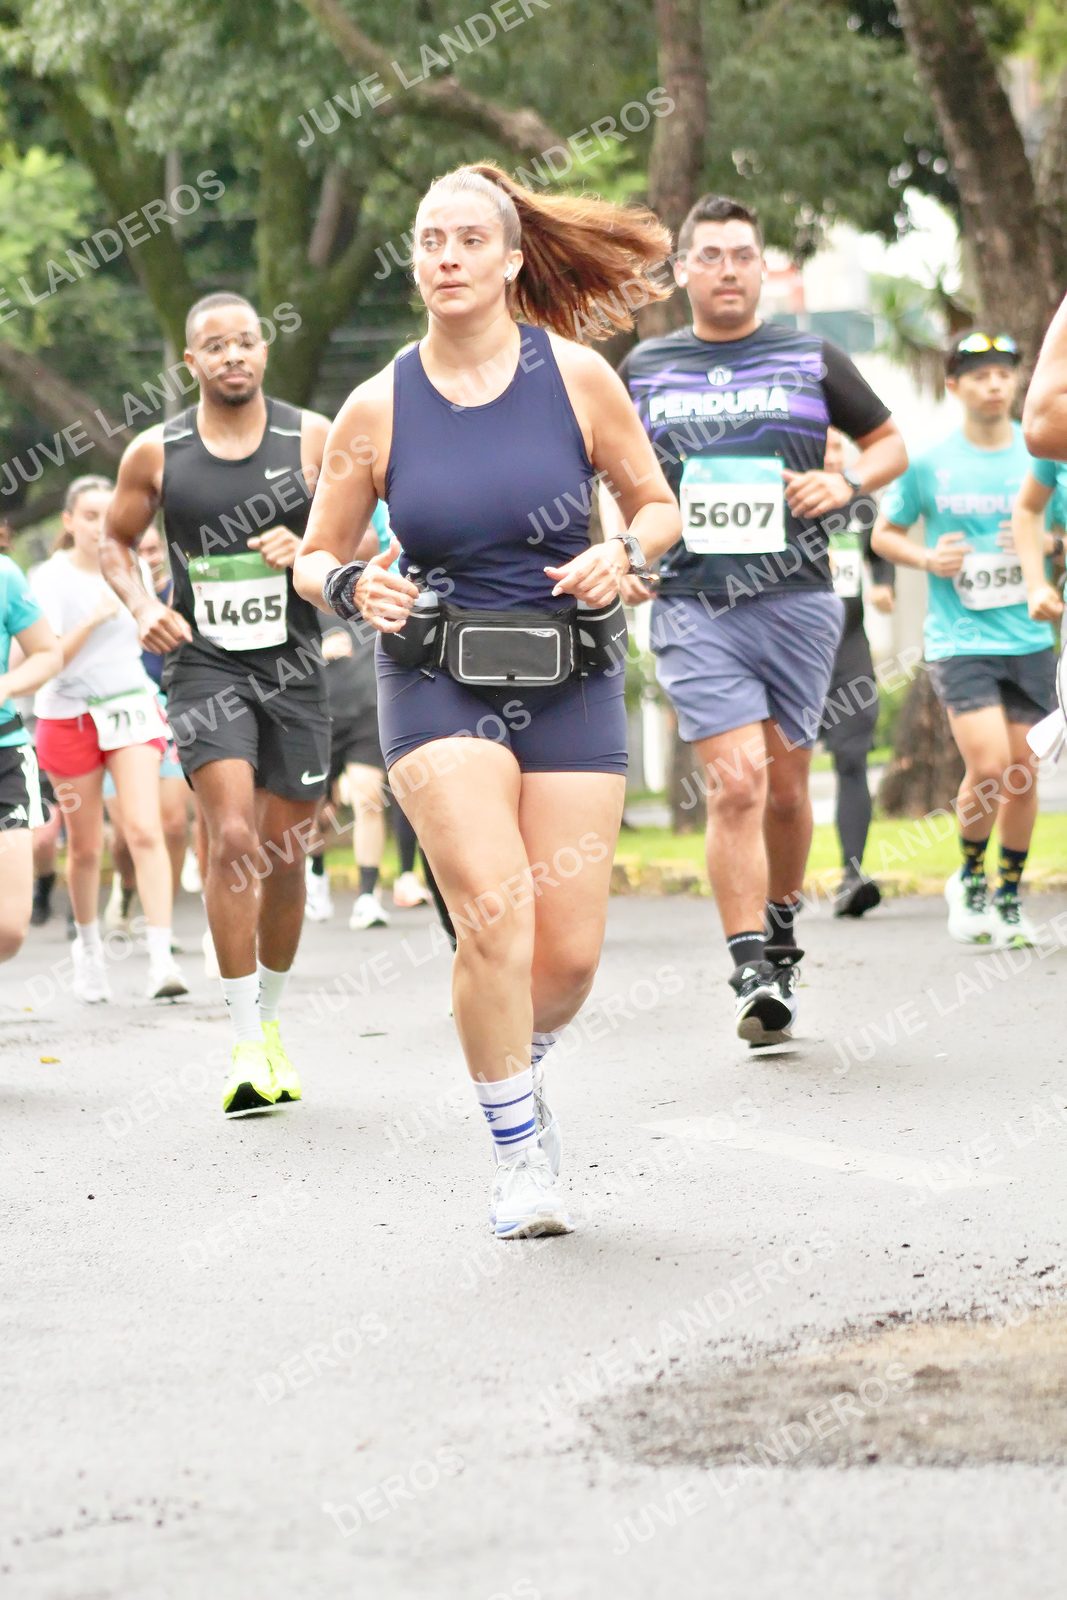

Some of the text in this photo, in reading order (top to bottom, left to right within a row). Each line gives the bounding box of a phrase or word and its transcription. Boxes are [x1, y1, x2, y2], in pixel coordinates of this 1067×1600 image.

[649, 386, 788, 422] PERDURA
[688, 502, 775, 529] 5607
[958, 566, 1023, 591] 4958
[204, 594, 282, 626] 1465
